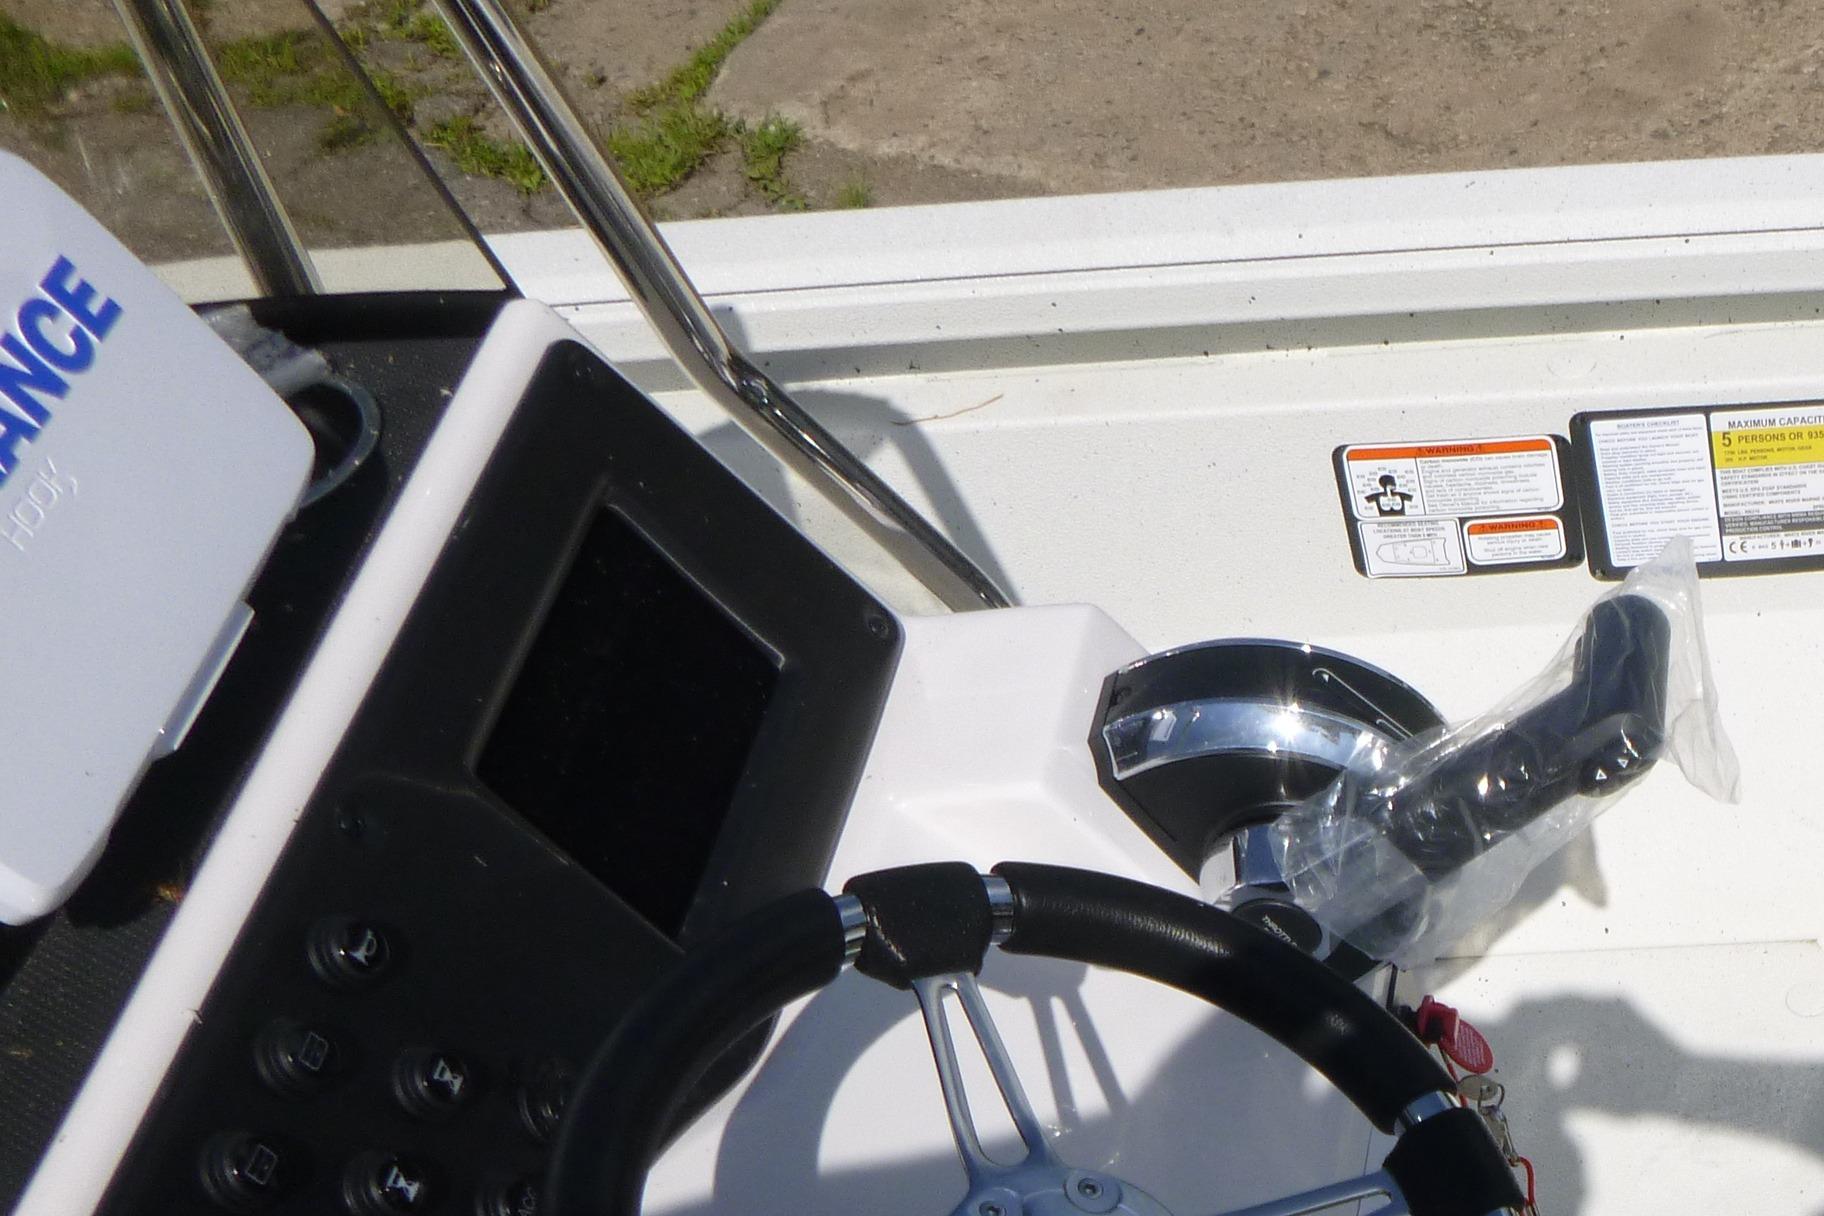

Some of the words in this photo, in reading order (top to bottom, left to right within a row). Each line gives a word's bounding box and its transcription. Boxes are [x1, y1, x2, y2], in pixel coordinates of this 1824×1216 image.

[1728, 418, 1776, 430] MAXIMUM
[1721, 432, 1732, 447] 5
[1738, 433, 1786, 444] PERSONS
[1789, 431, 1804, 441] OR
[1808, 430, 1824, 439] 935
[1425, 445, 1475, 455] WARNING
[1488, 522, 1536, 530] WARNING
[1729, 541, 1748, 554] CE
